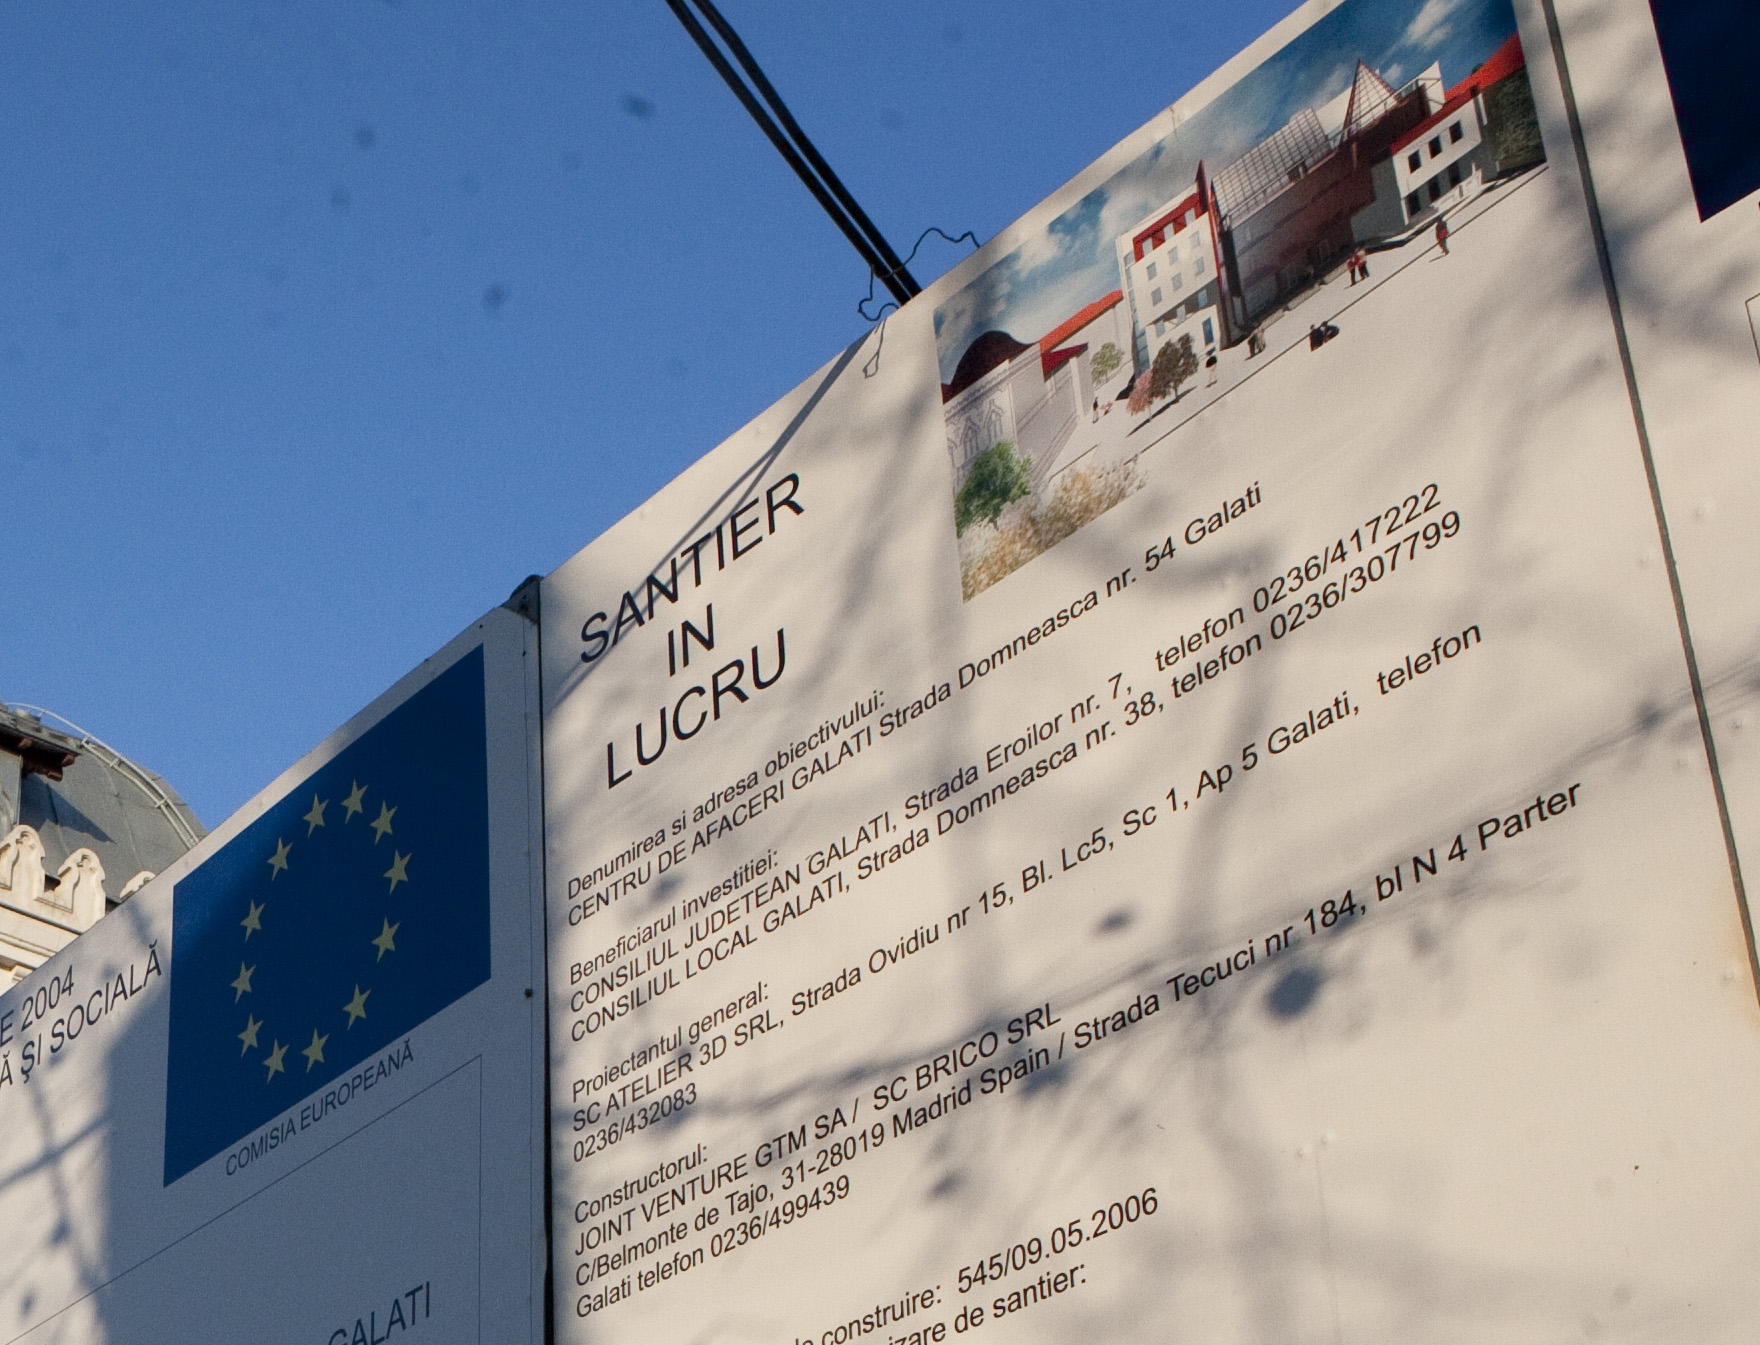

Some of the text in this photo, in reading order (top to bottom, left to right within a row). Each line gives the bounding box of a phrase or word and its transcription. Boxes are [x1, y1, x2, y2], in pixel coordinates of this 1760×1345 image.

[580, 472, 804, 665] SANTIER
[667, 602, 716, 678] IN
[568, 480, 1262, 927] CENTRU DE AFACERI GALATI Strada Domneasca nr. 54 Galati
[570, 482, 1441, 1013] CONSILIUL JUDETEAN GALATI, Strada Eroilor nr. 7, telefon 0236/417222
[606, 627, 787, 790] LUCRU
[567, 689, 885, 901] Denumirea si adresa obiectivului:
[20, 963, 75, 1033] 2004
[50, 935, 163, 1056] SOCIALĂ
[225, 1117, 297, 1177] COMISIA
[574, 1143, 708, 1224] Constructorul:
[957, 1186, 1159, 1295] 545/09.05.2006
